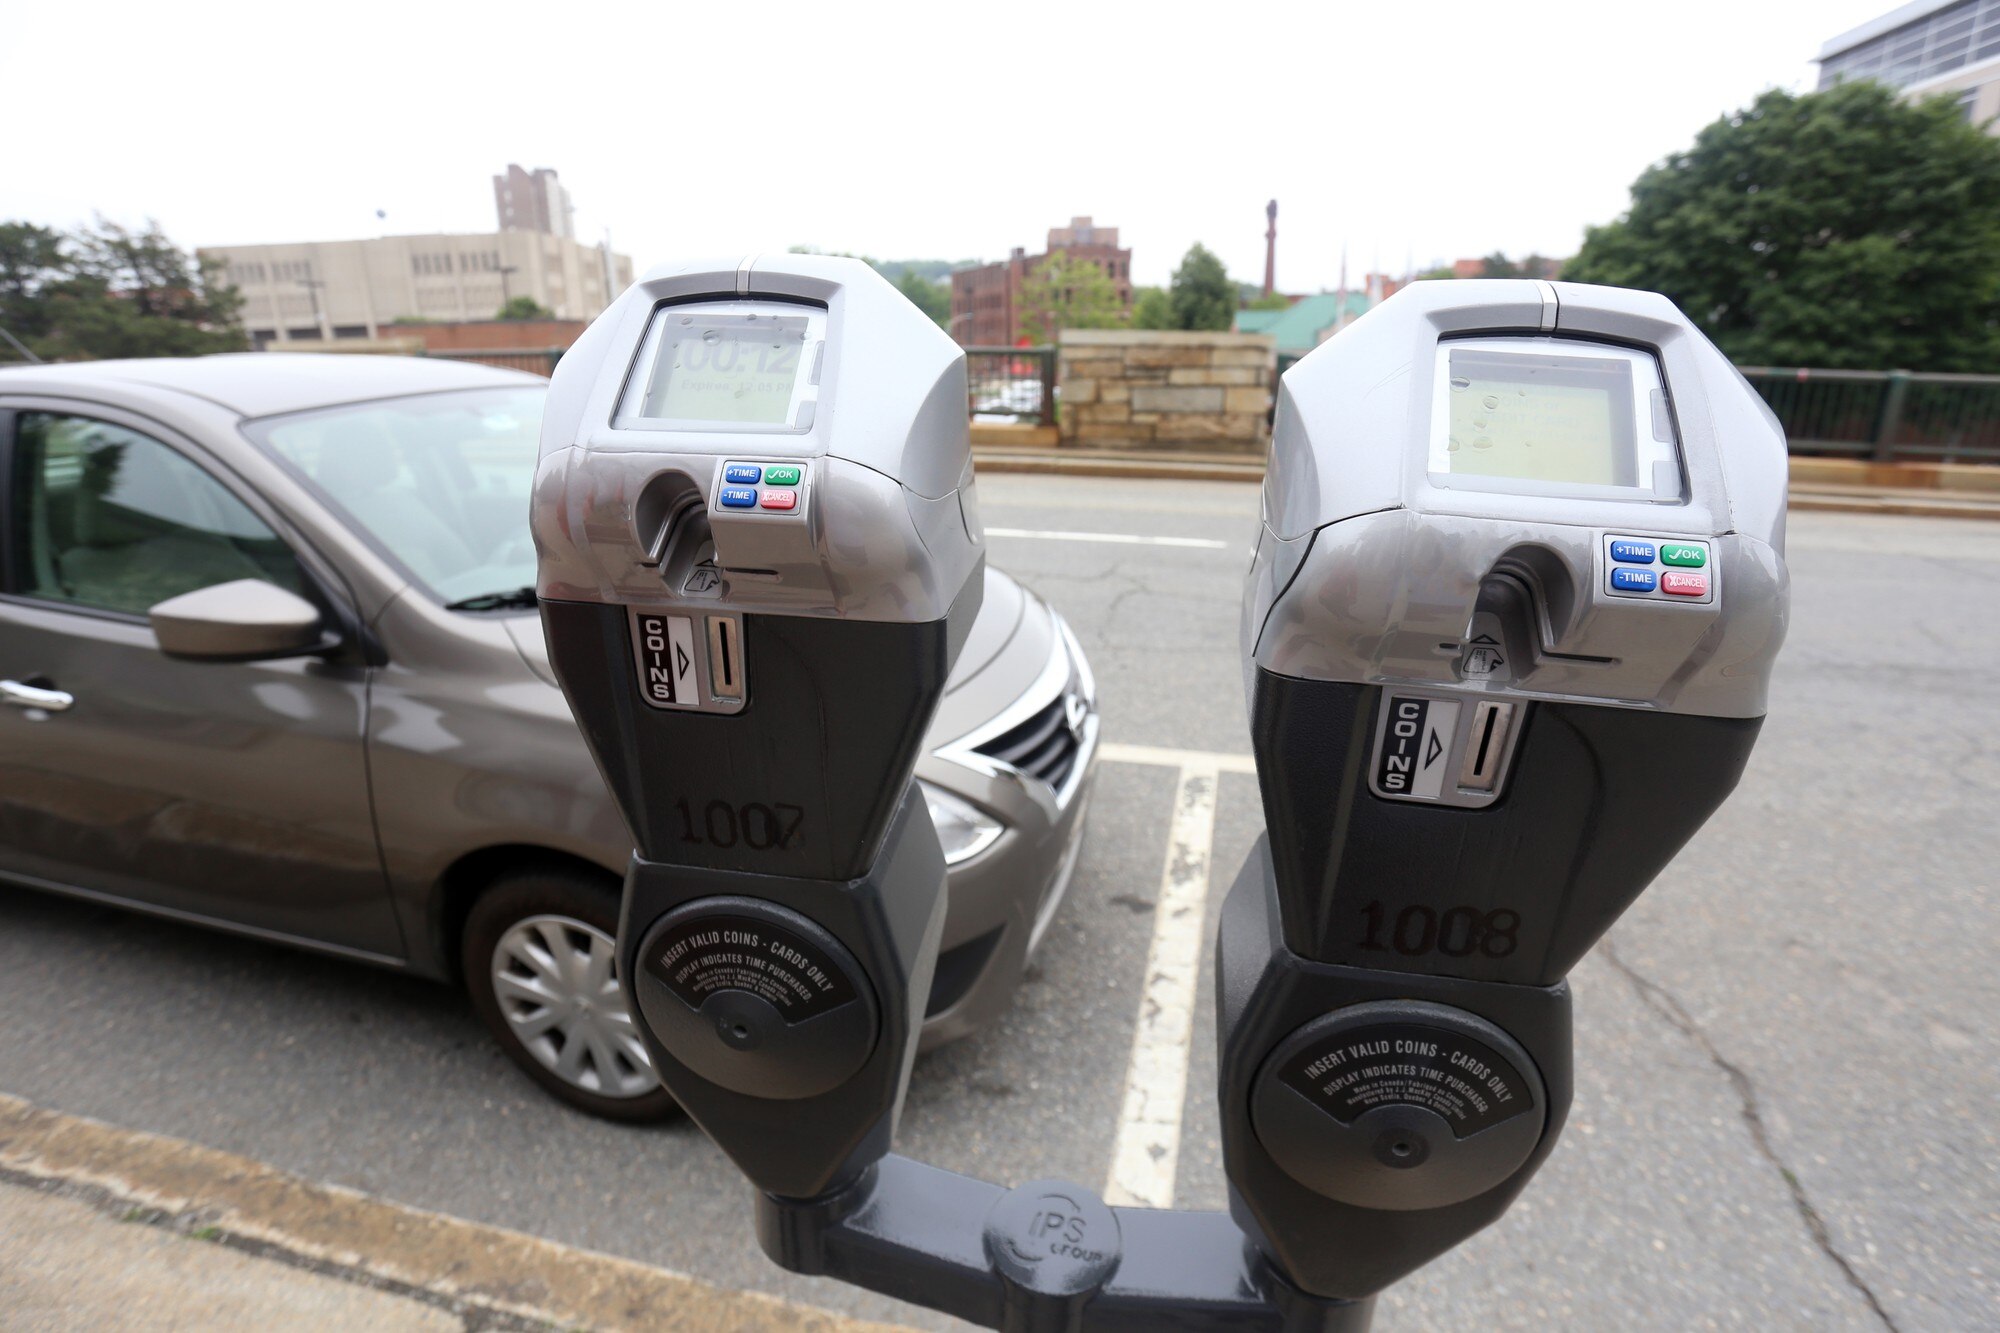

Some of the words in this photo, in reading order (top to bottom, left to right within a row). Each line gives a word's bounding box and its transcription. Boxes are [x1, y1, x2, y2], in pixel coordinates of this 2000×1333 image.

[727, 469, 756, 477] +TIME
[724, 491, 750, 500] -TIME
[1617, 546, 1653, 557] +TIME
[1619, 572, 1653, 583] -TIME
[645, 619, 670, 699] COINS
[1385, 703, 1420, 789] COINS
[676, 798, 805, 850] 1007
[1357, 900, 1521, 959] 1008
[660, 940, 690, 970] INSERT
[689, 931, 720, 950] VALID
[724, 930, 759, 948] COINS
[771, 941, 809, 970] CARDS
[807, 965, 835, 993] ONLY
[675, 961, 700, 984] DISPLAY
[700, 953, 742, 967] INDICATES
[745, 956, 767, 970] TIME
[1304, 1049, 1347, 1080] INSERT
[1349, 1040, 1390, 1059] VALID
[1395, 1040, 1438, 1057] COINS
[1450, 1050, 1491, 1080] CARDS
[1487, 1072, 1513, 1104] ONLY
[1323, 1071, 1360, 1096] DISPLAY
[1361, 1065, 1416, 1079] INDICATES
[1420, 1066, 1445, 1082] TIME
[1028, 1211, 1087, 1243] IPS
